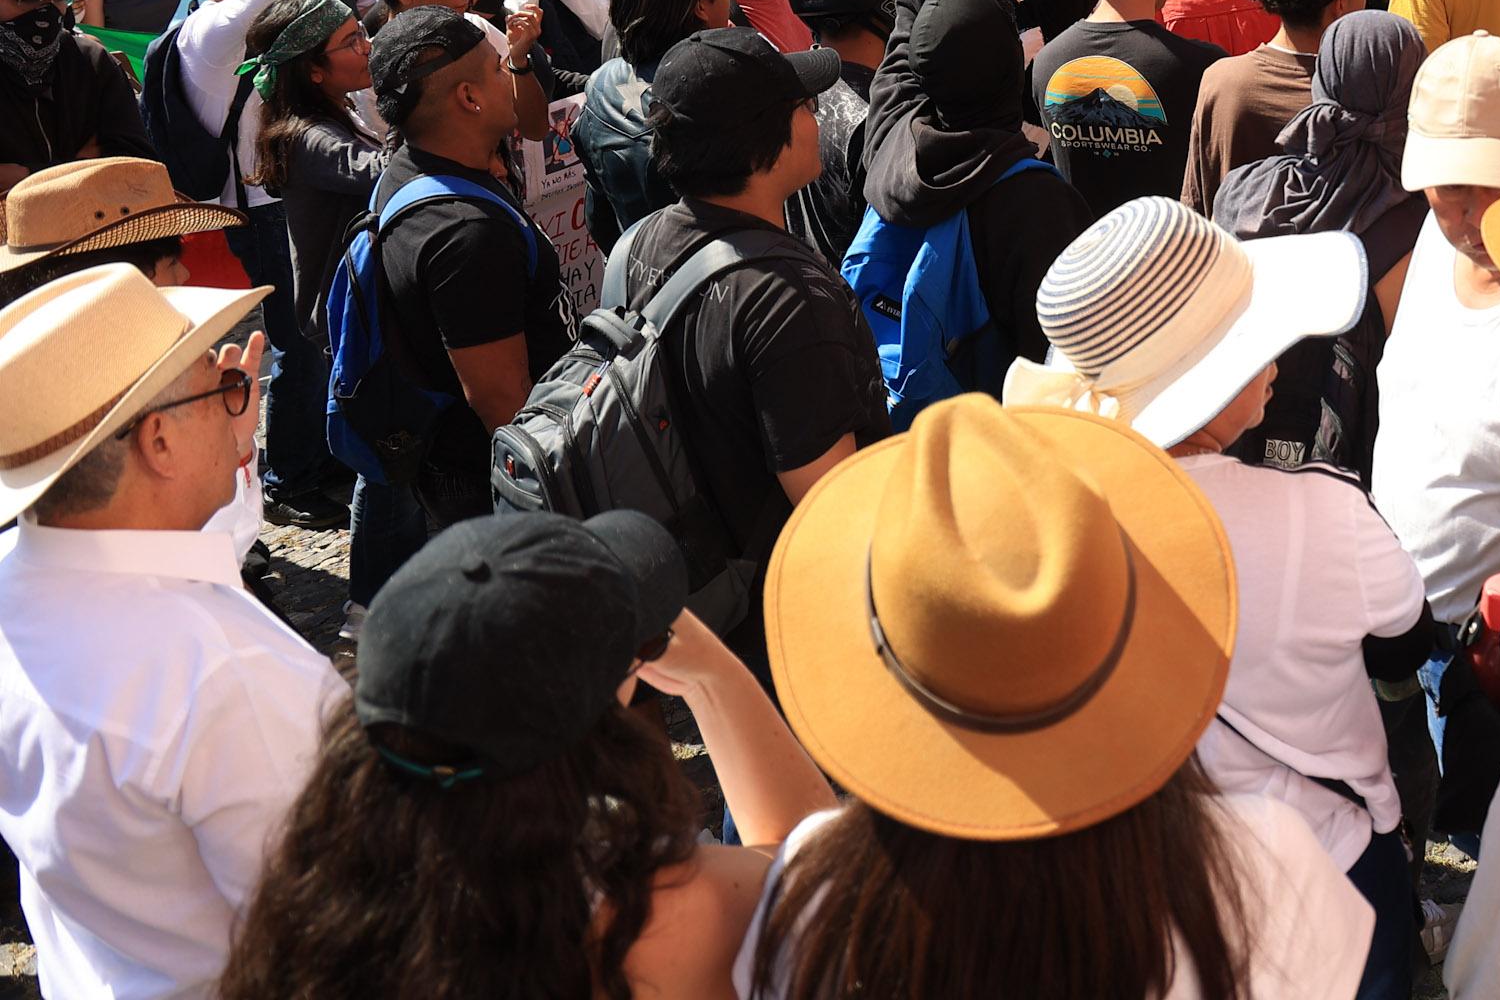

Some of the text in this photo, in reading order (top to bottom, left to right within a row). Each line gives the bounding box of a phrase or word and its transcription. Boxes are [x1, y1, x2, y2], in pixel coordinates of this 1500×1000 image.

[1051, 121, 1163, 145] COLUMBIA
[1060, 140, 1152, 153] SPORTSWEAR CO.
